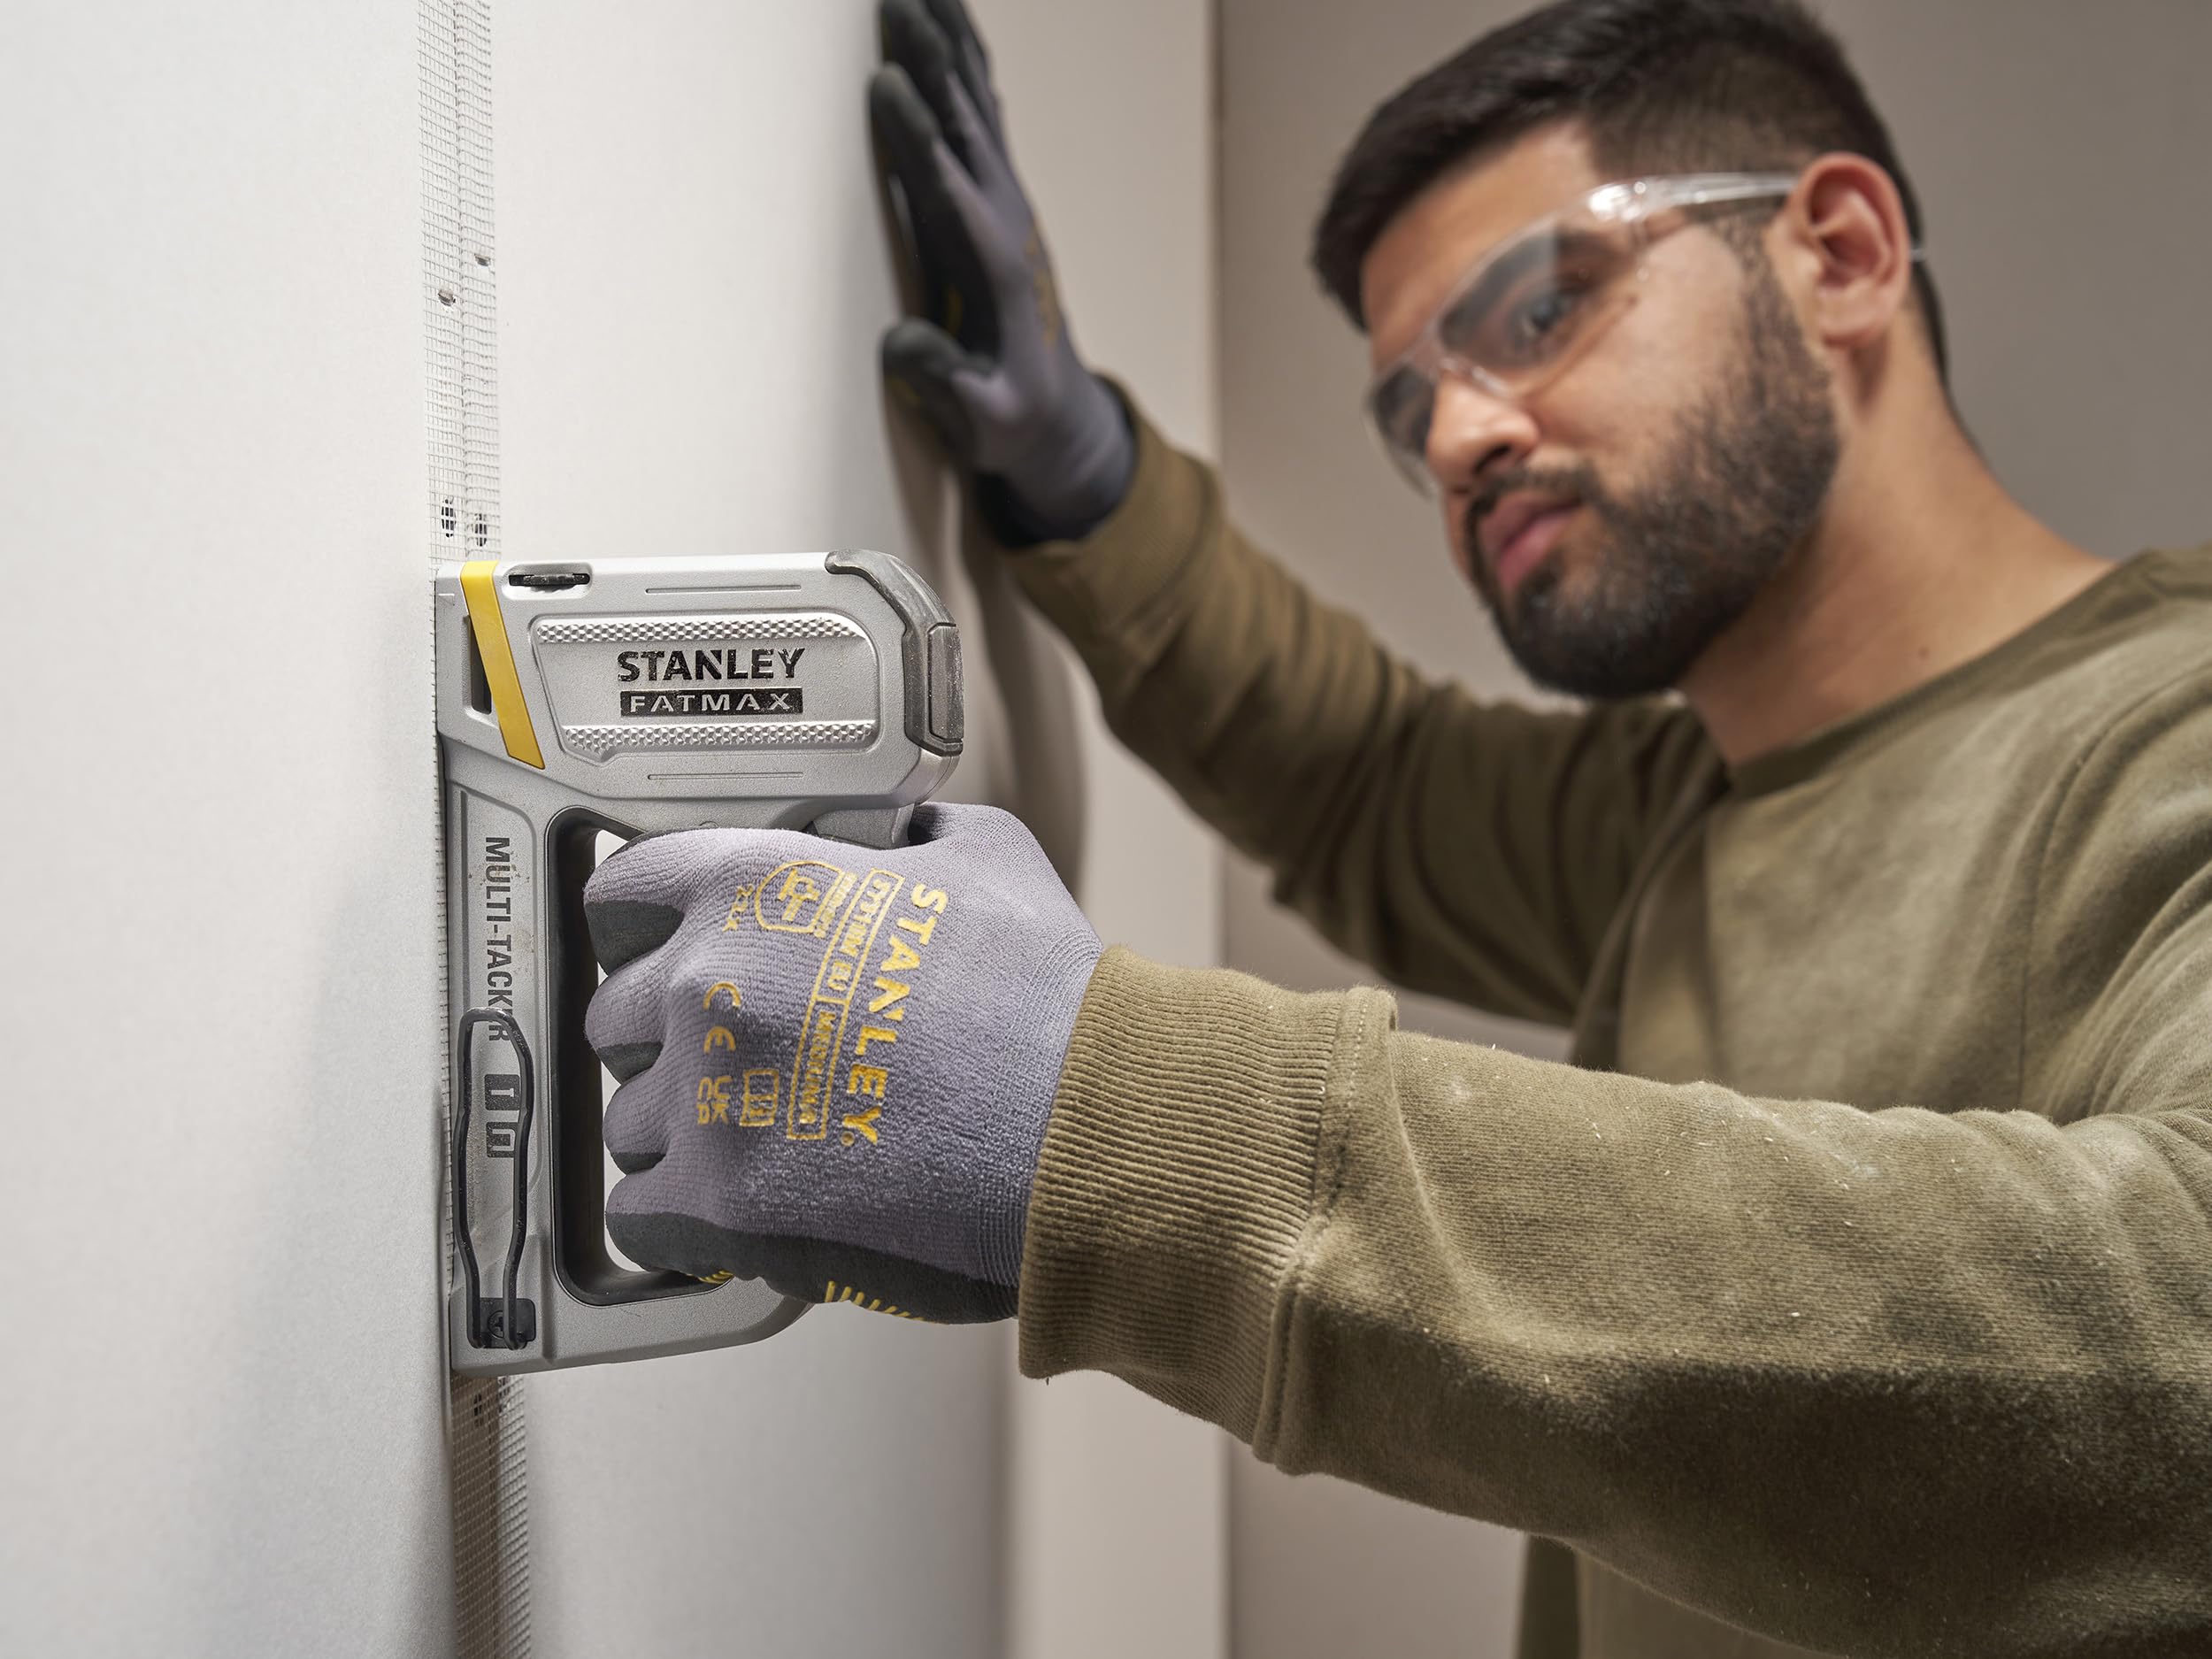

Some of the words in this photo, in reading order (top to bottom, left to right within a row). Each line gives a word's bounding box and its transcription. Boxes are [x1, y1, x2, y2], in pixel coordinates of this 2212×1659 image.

[618, 649, 804, 681] STANLEY
[630, 693, 790, 712] FATMAX
[486, 837, 513, 1041] MULTI-TACKR
[843, 883, 949, 1145] STANLEY
